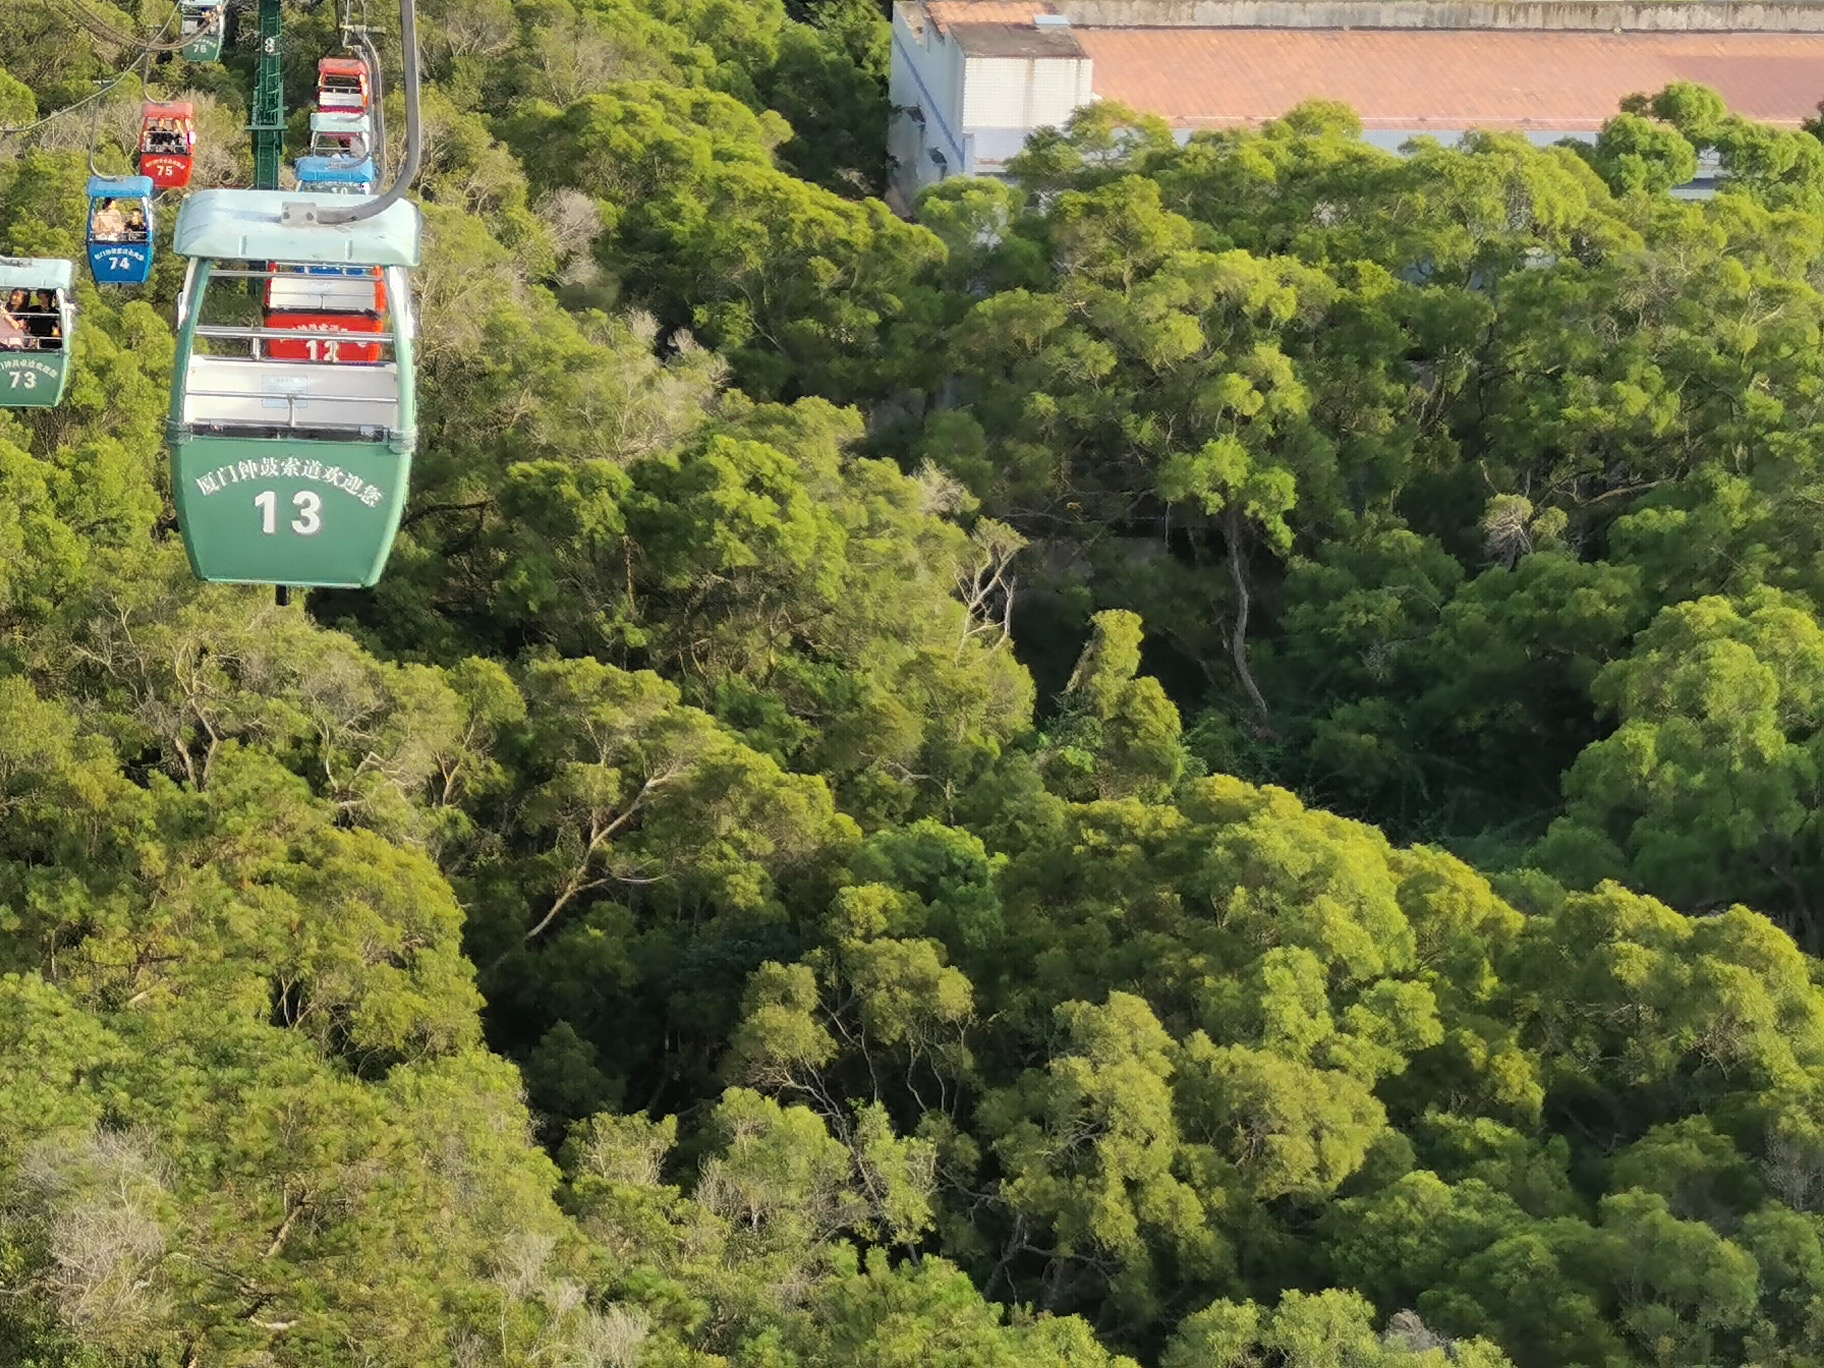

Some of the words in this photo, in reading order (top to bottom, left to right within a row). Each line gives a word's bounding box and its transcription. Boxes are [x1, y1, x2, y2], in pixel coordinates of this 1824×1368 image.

[156, 165, 173, 176] 75
[108, 257, 130, 271] 74
[305, 340, 340, 363] 12
[8, 371, 37, 389] 73
[194, 455, 383, 509] 厦门钟鼓索道欢迎您
[254, 490, 322, 534] 13
